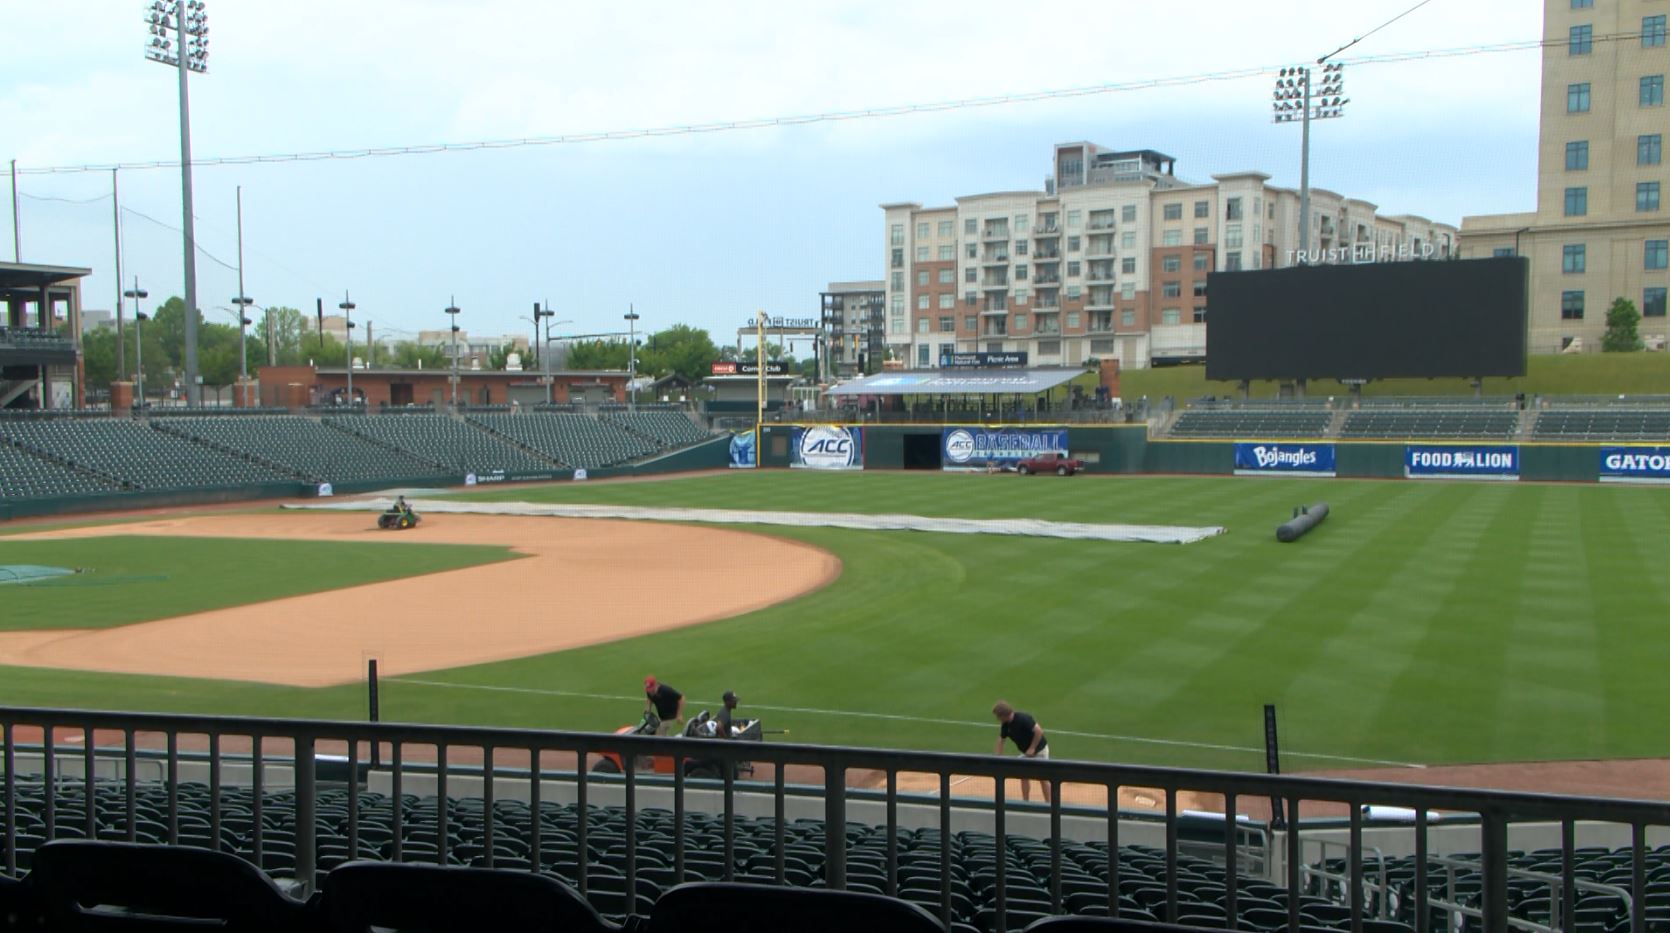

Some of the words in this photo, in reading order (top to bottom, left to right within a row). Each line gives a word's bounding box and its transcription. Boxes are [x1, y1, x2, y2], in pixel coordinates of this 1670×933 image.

[1287, 247, 1349, 263] TRUIST
[1380, 242, 1434, 259] FIELD
[807, 439, 852, 453] ACC
[951, 440, 972, 449] ACC
[975, 433, 1060, 451] BASEBALL
[1253, 446, 1317, 467] Bojangles
[1412, 452, 1452, 467] FOOD
[1476, 453, 1512, 468] LION
